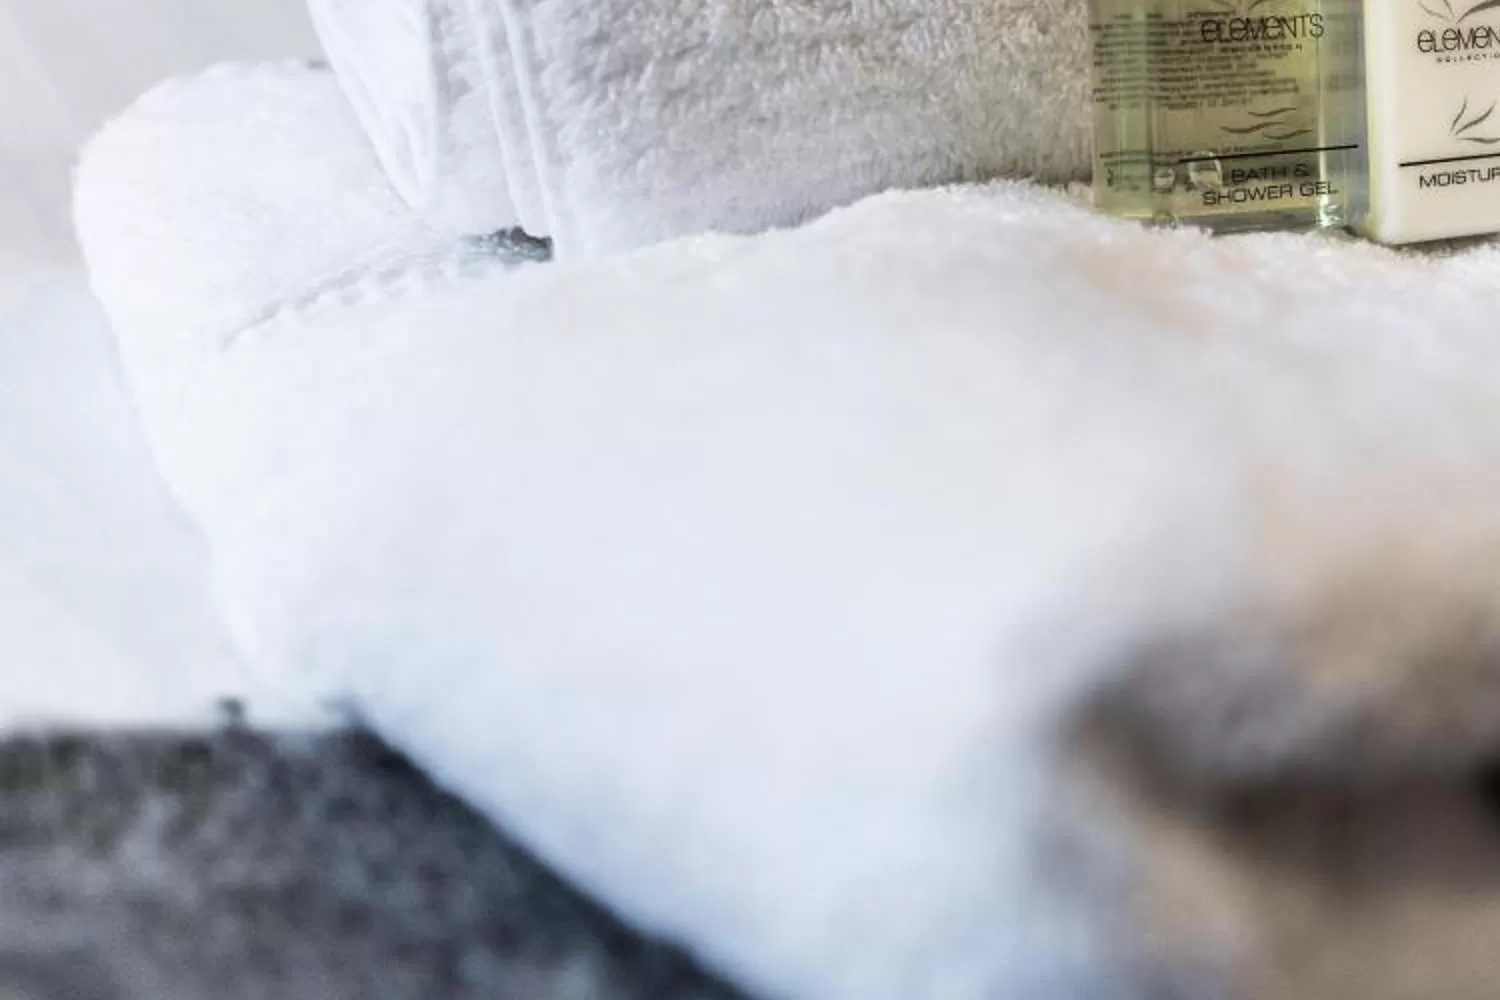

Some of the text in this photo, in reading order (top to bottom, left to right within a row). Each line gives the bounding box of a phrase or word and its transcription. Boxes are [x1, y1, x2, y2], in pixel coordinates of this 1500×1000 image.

[1230, 166, 1287, 184] BATH
[1202, 181, 1339, 206] SHOWER GEL
